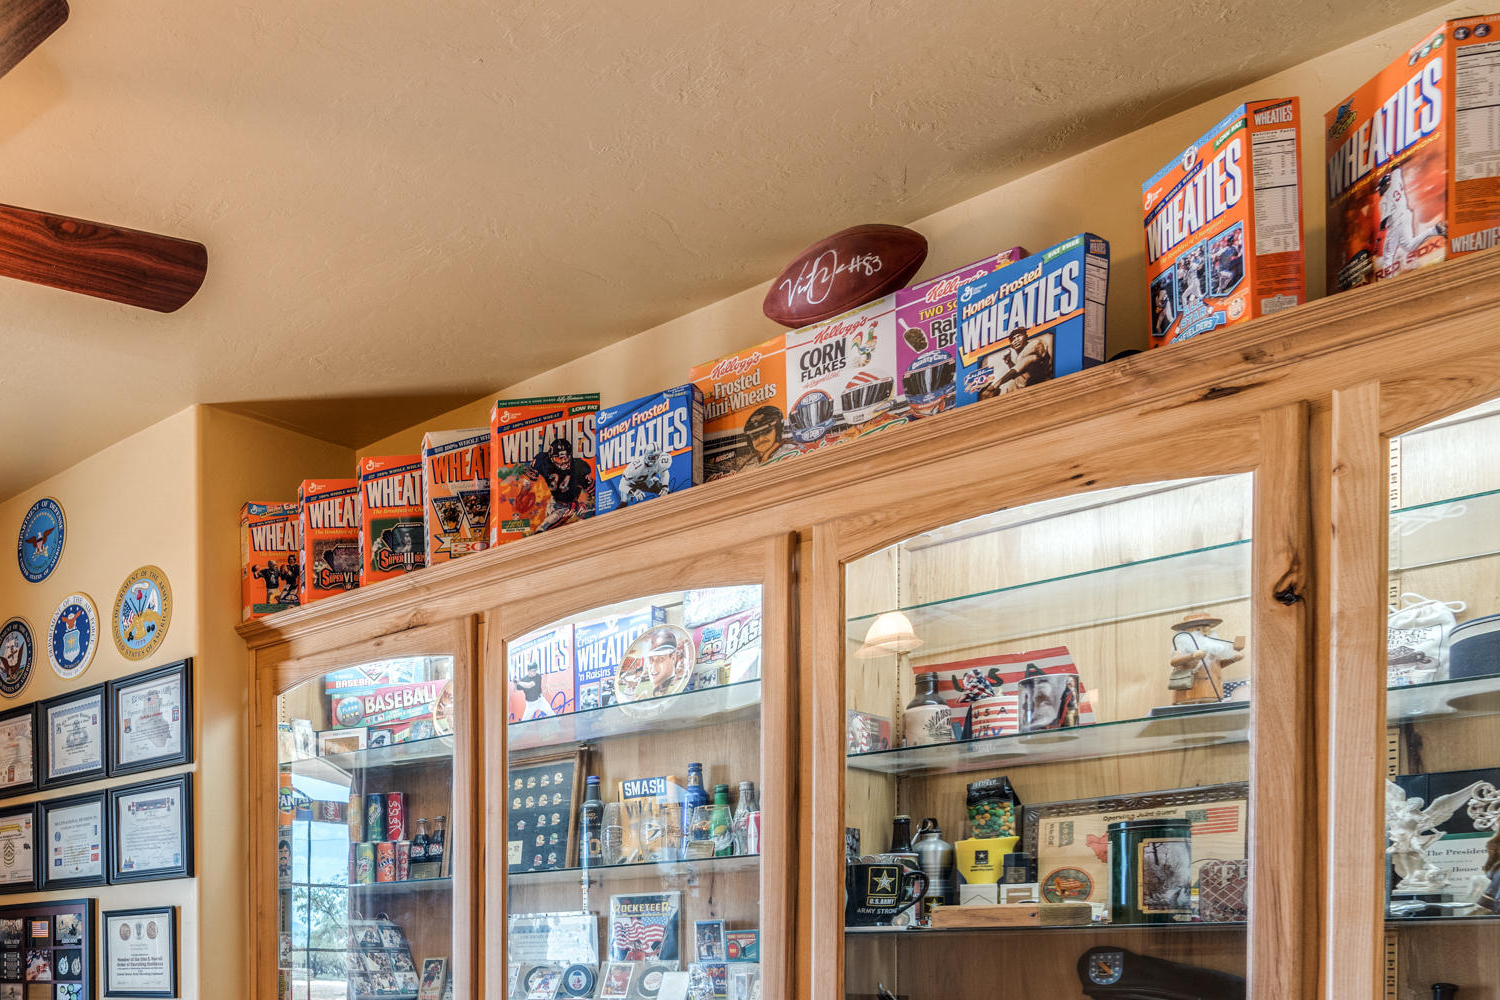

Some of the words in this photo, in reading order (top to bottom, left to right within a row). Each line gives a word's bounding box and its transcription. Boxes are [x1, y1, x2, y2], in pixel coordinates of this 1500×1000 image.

[1254, 105, 1292, 126] WHEATIES
[1329, 57, 1442, 199] WHEATIES
[1148, 138, 1242, 265] WHEATIES
[1452, 227, 1500, 253] WHEATIE
[1375, 260, 1400, 280] RED
[1406, 238, 1444, 263] SOX
[962, 260, 1079, 356] WHEATIES
[963, 292, 998, 320] Honey
[999, 262, 1043, 299] Frosted
[919, 305, 944, 321] TWO
[813, 316, 868, 345] Kellogg's
[711, 352, 762, 379] Kellogg's
[800, 337, 846, 371] CORN
[800, 357, 846, 382] FLAKES
[714, 368, 760, 399] Frosted
[599, 419, 632, 443] Honey
[632, 398, 669, 427] Frosted
[503, 414, 596, 463] WHEATIES
[599, 407, 687, 471] WHEATIES
[549, 473, 571, 493] 34
[19, 503, 40, 550] DEPARTMENT
[114, 573, 139, 618] DEPARTMENT
[149, 571, 159, 580] THE
[159, 581, 168, 604] ARMY
[114, 625, 126, 652] UNITED
[125, 649, 145, 658] STATES
[153, 607, 168, 647] AMERICA
[586, 668, 611, 681] Raisins
[624, 778, 666, 797] SMASH
[614, 901, 669, 913] ROCKETEER
